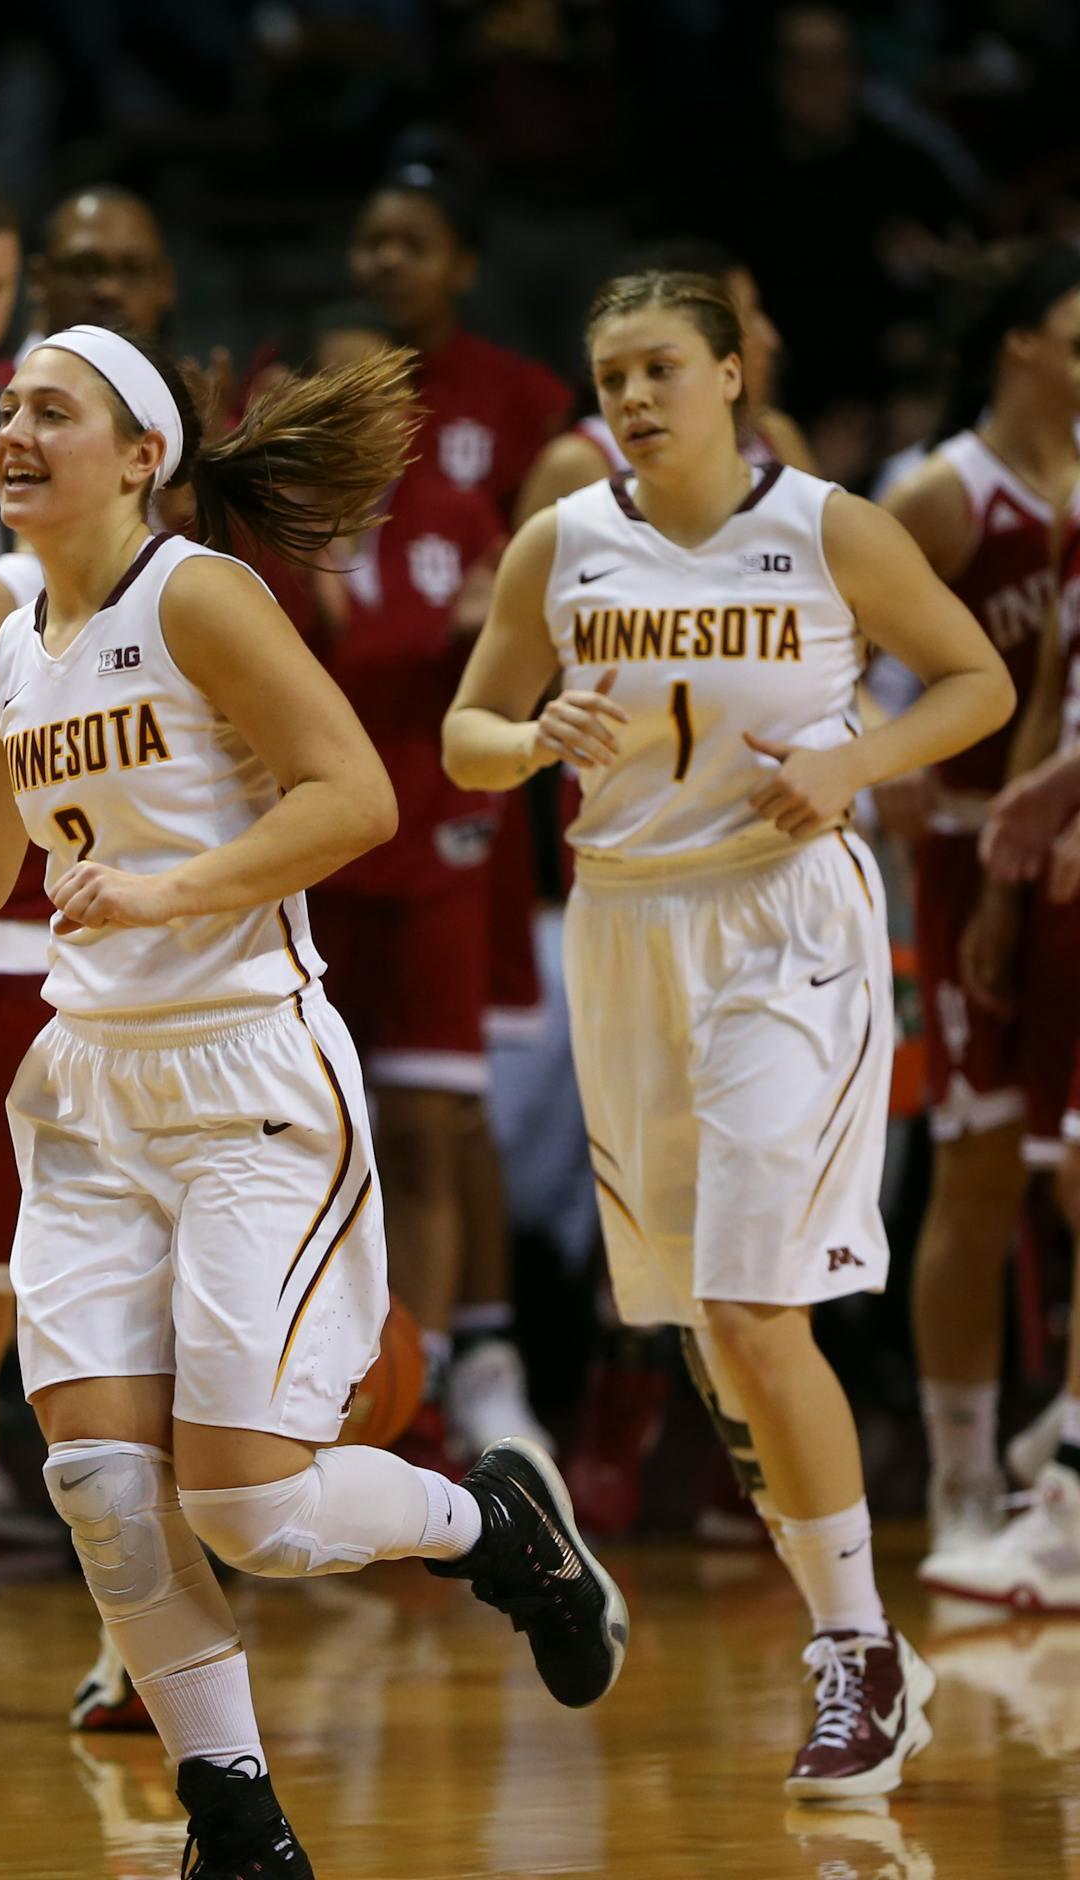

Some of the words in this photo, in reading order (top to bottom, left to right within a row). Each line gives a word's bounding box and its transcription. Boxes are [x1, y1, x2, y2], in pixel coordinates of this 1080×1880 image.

[574, 604, 802, 664] MINNESOTA
[4, 701, 172, 795] INNESOTA
[669, 680, 695, 783] 1
